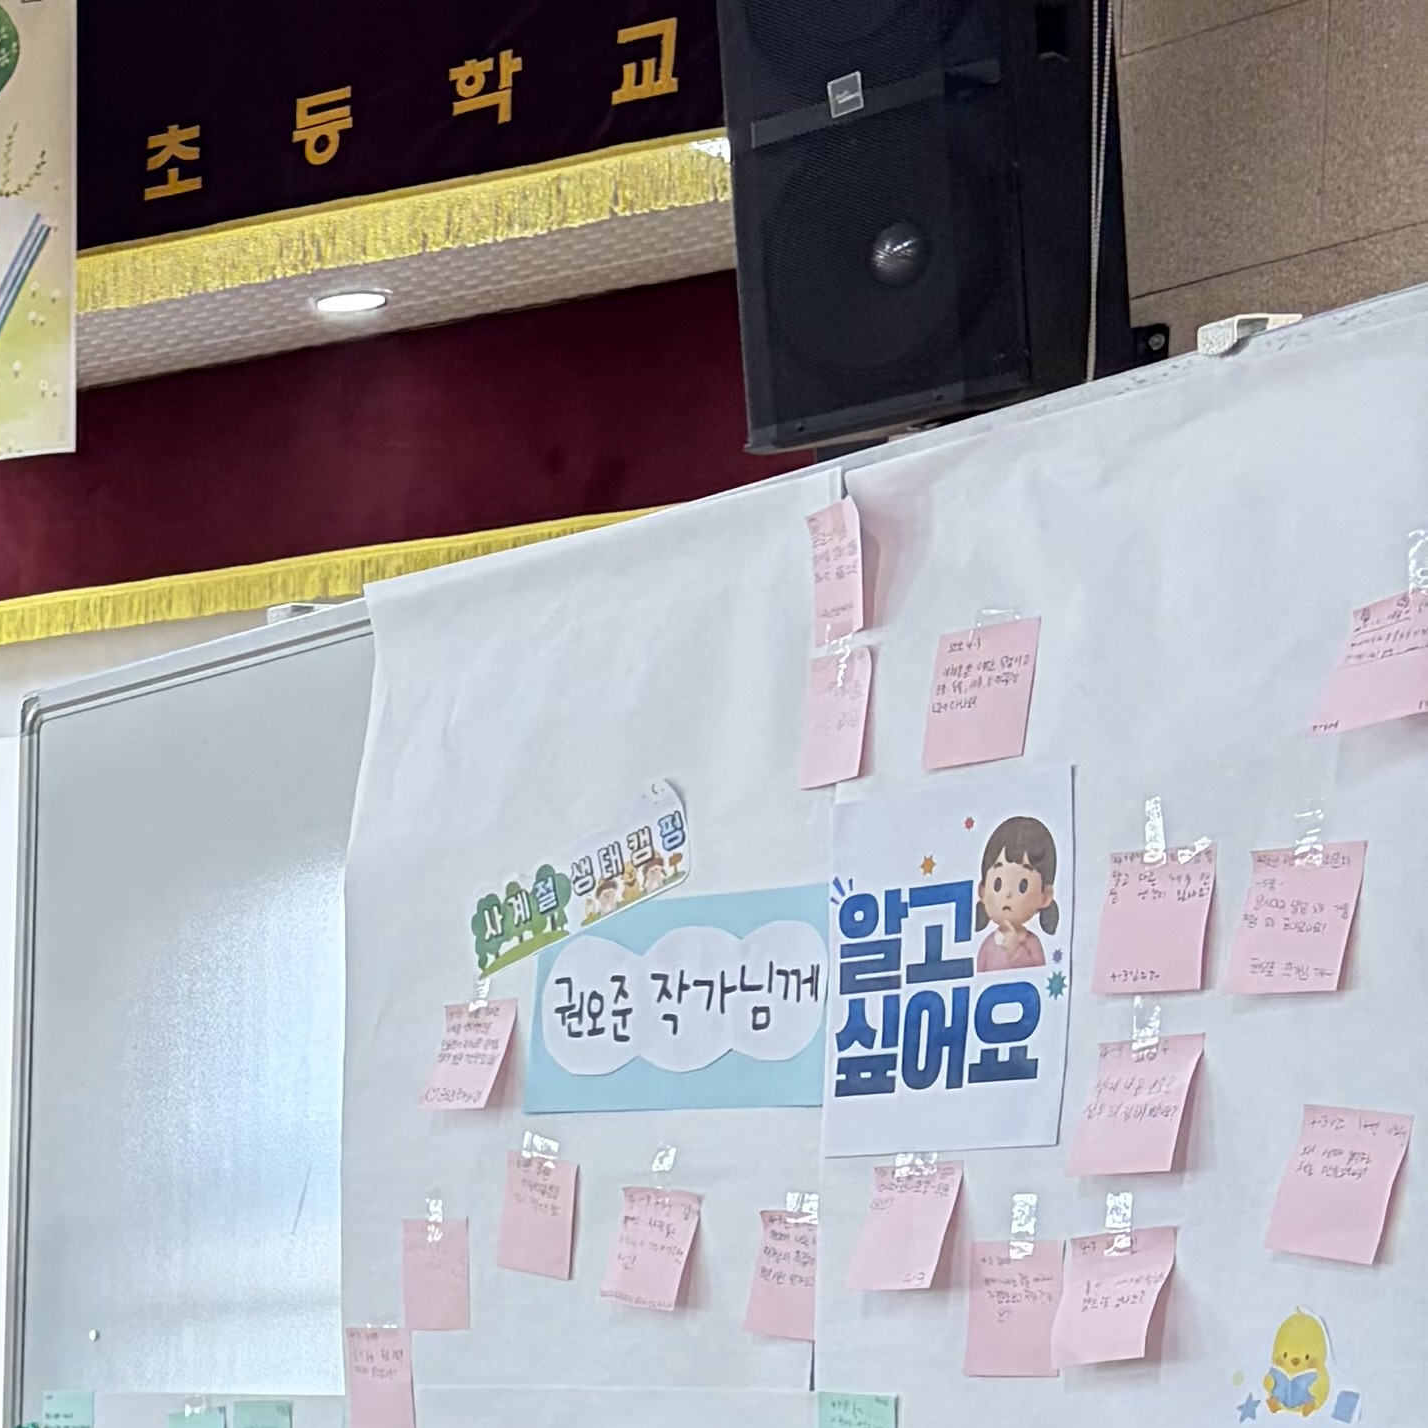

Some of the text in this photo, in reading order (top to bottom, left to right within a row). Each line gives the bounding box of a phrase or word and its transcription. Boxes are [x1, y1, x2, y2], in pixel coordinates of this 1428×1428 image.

[838, 880, 975, 996] 알고
[554, 960, 821, 1043] 권오준 작가님께
[834, 980, 1042, 1098] 싶어요
